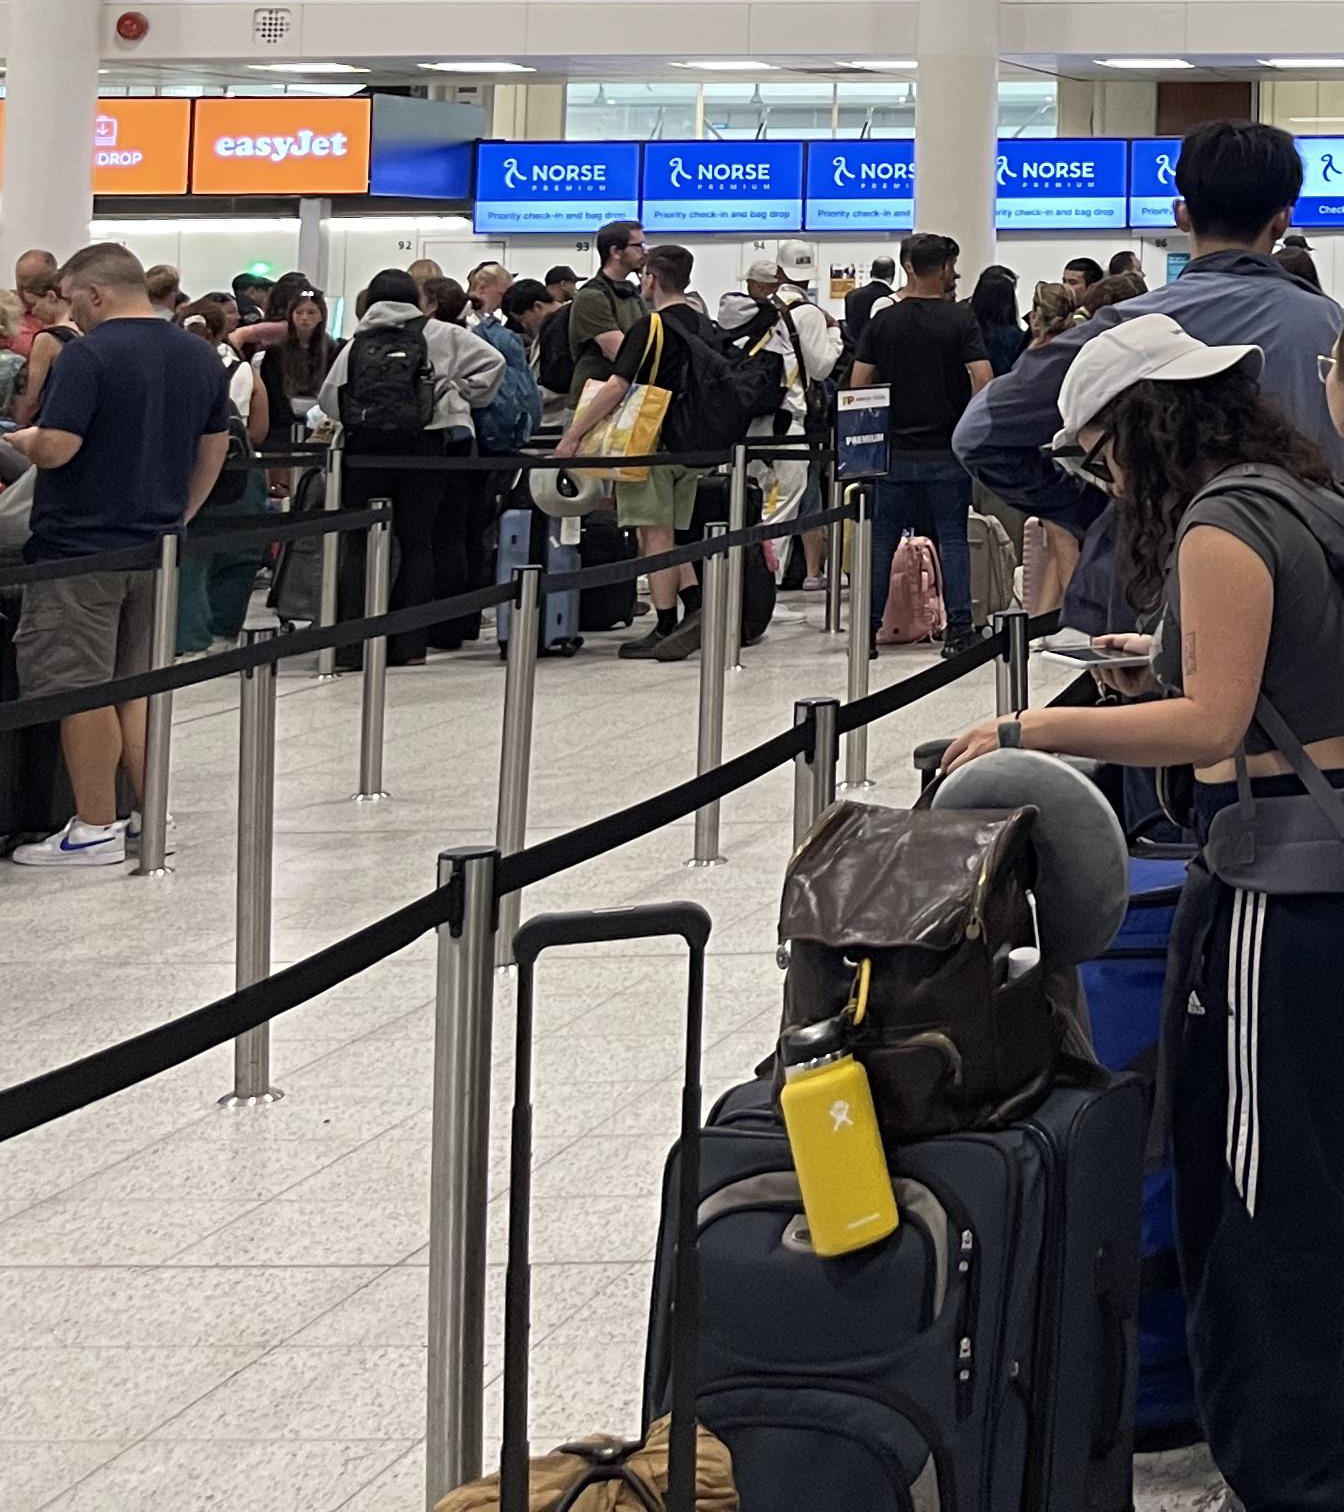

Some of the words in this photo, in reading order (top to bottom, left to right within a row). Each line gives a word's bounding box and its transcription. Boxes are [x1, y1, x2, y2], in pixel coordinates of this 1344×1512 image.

[216, 129, 348, 162] easyJet
[96, 152, 143, 166] DROP
[532, 163, 607, 182] NORSE
[698, 163, 770, 180] NORSE
[861, 162, 915, 179] NORS
[1022, 162, 1095, 178] NORSE
[523, 211, 564, 219] check-in
[565, 211, 583, 219] and
[585, 211, 604, 221] bag
[688, 210, 729, 218] check-in
[731, 210, 748, 218] and
[750, 210, 767, 220] bag
[769, 210, 790, 220] drop
[852, 209, 892, 217] check-in
[893, 209, 911, 217] and
[1055, 208, 1072, 216] and
[1074, 208, 1091, 218] bag
[1093, 208, 1114, 218] drop
[398, 240, 412, 250] 92
[576, 241, 590, 252] 93
[753, 240, 766, 251] 94
